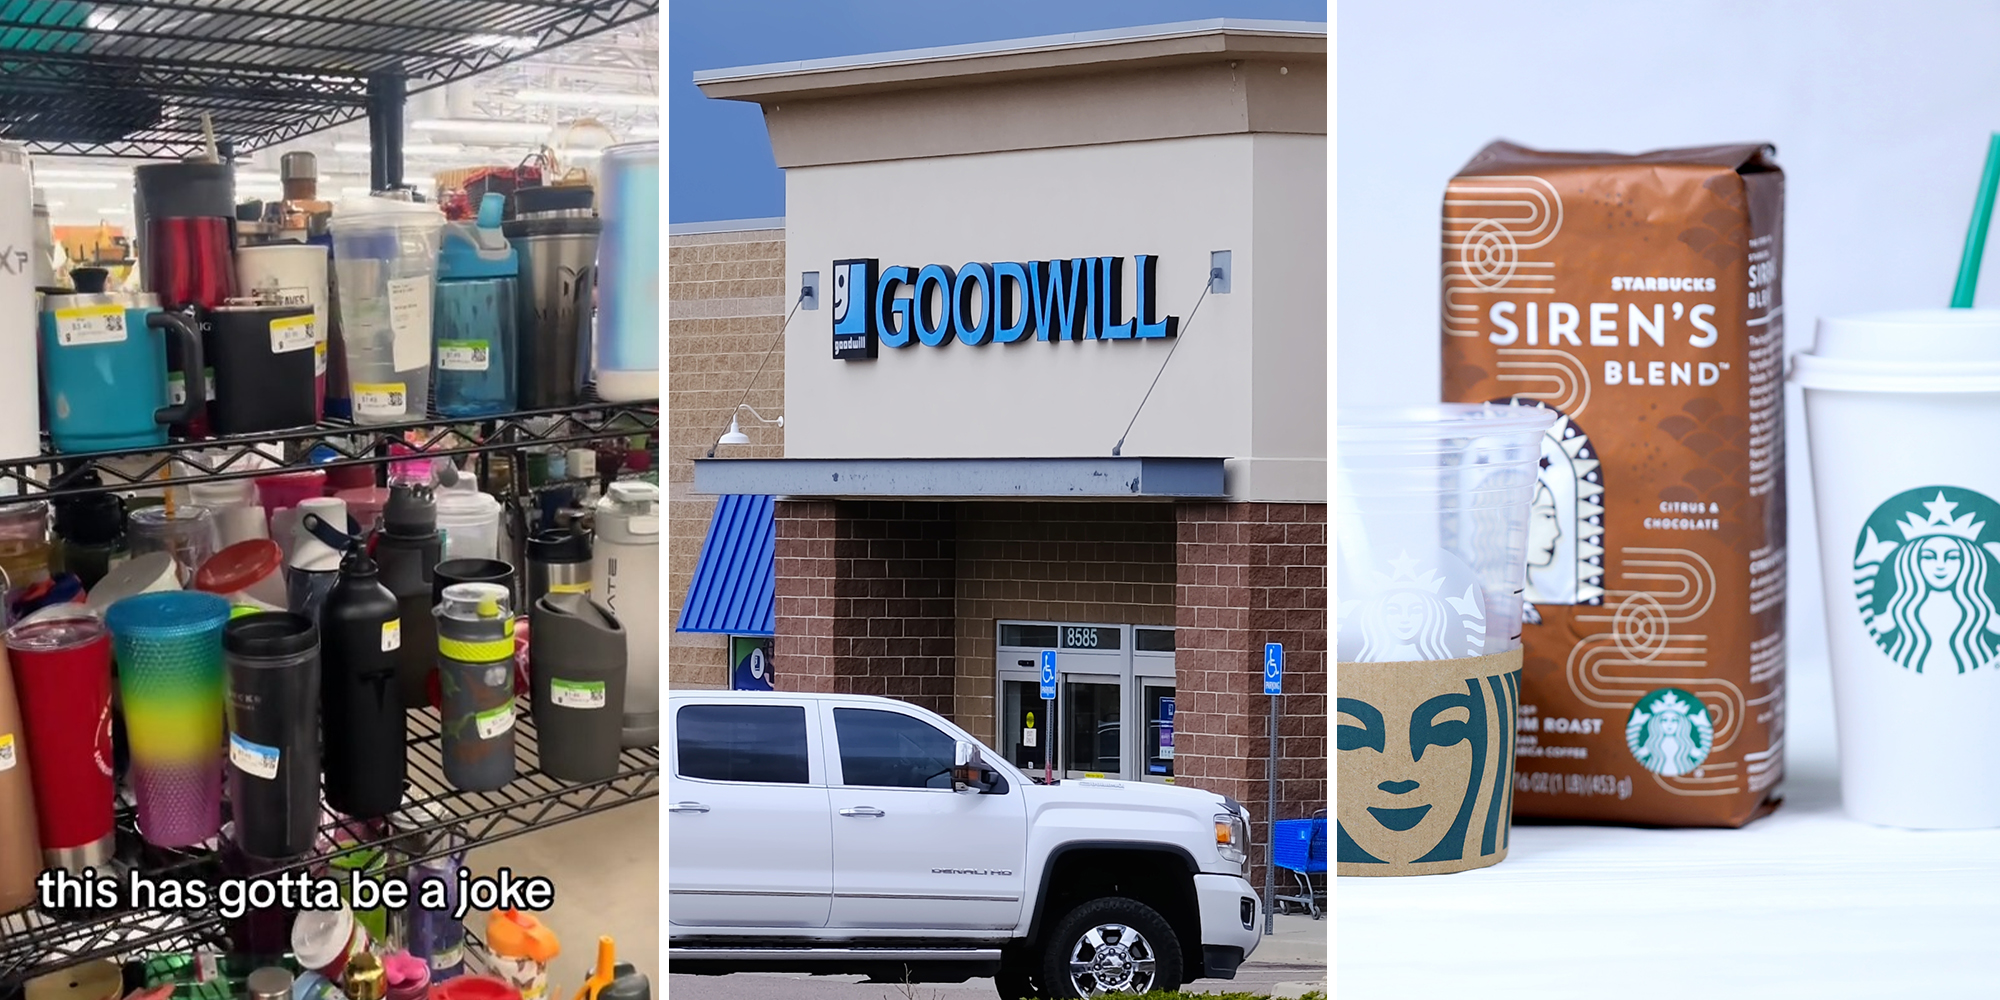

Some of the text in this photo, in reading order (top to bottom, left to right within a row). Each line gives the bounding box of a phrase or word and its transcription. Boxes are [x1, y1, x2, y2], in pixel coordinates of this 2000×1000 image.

[1611, 276, 1717, 292] STARBUCKS
[876, 255, 1173, 348] GOODWILL
[1488, 300, 1719, 349] SIREN'S
[834, 336, 866, 355] goodwill
[1659, 501, 1706, 514] CITRUS
[1643, 516, 1720, 531] CHOCOLATE
[1067, 627, 1098, 647] 8585
[1543, 716, 1604, 734] ROAST
[1545, 746, 1588, 760] COFFEE
[931, 867, 1013, 877] DENALI HD
